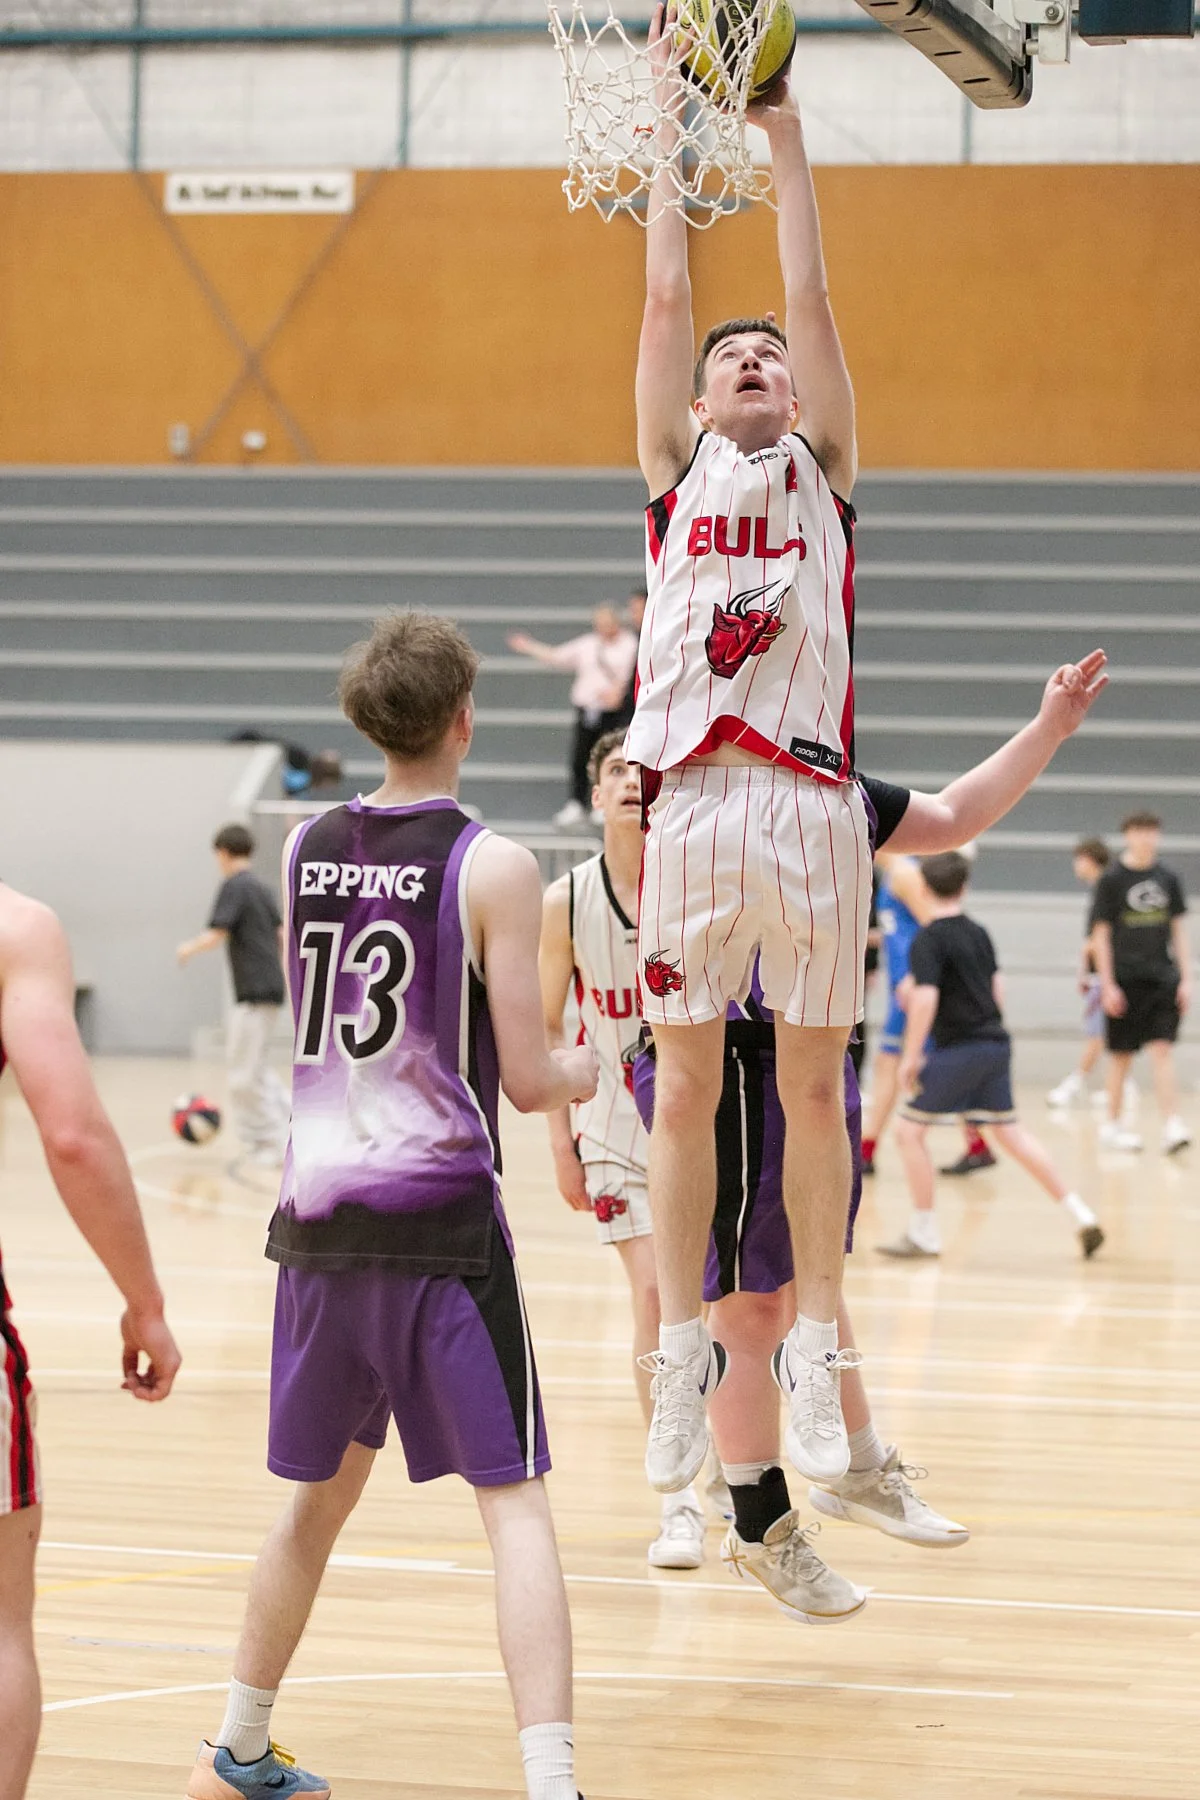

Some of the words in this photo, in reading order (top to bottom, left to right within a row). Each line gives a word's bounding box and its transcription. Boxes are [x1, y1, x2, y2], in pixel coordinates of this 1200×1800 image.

[687, 515, 807, 561] BUL
[825, 753, 838, 766] XL
[299, 861, 427, 902] EPPING
[294, 919, 416, 1066] 13
